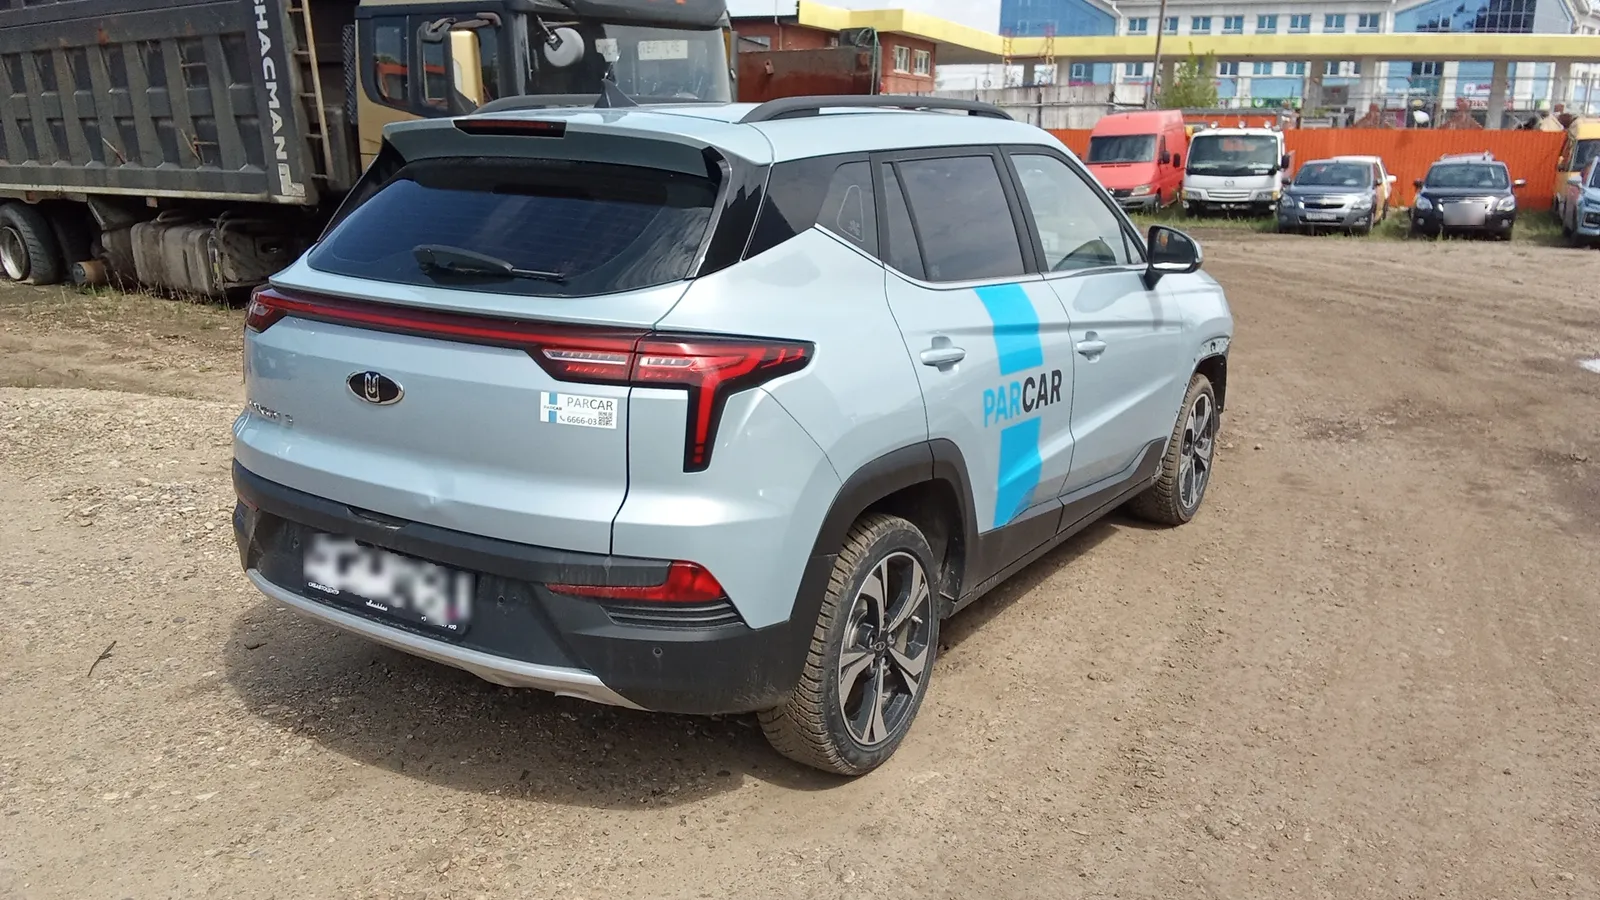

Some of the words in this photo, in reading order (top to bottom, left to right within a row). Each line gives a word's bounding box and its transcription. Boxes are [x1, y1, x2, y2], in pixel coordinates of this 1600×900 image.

[567, 396, 613, 411] PARCAR
[982, 368, 1062, 428] PARCAR
[566, 416, 597, 426] 6666-03
